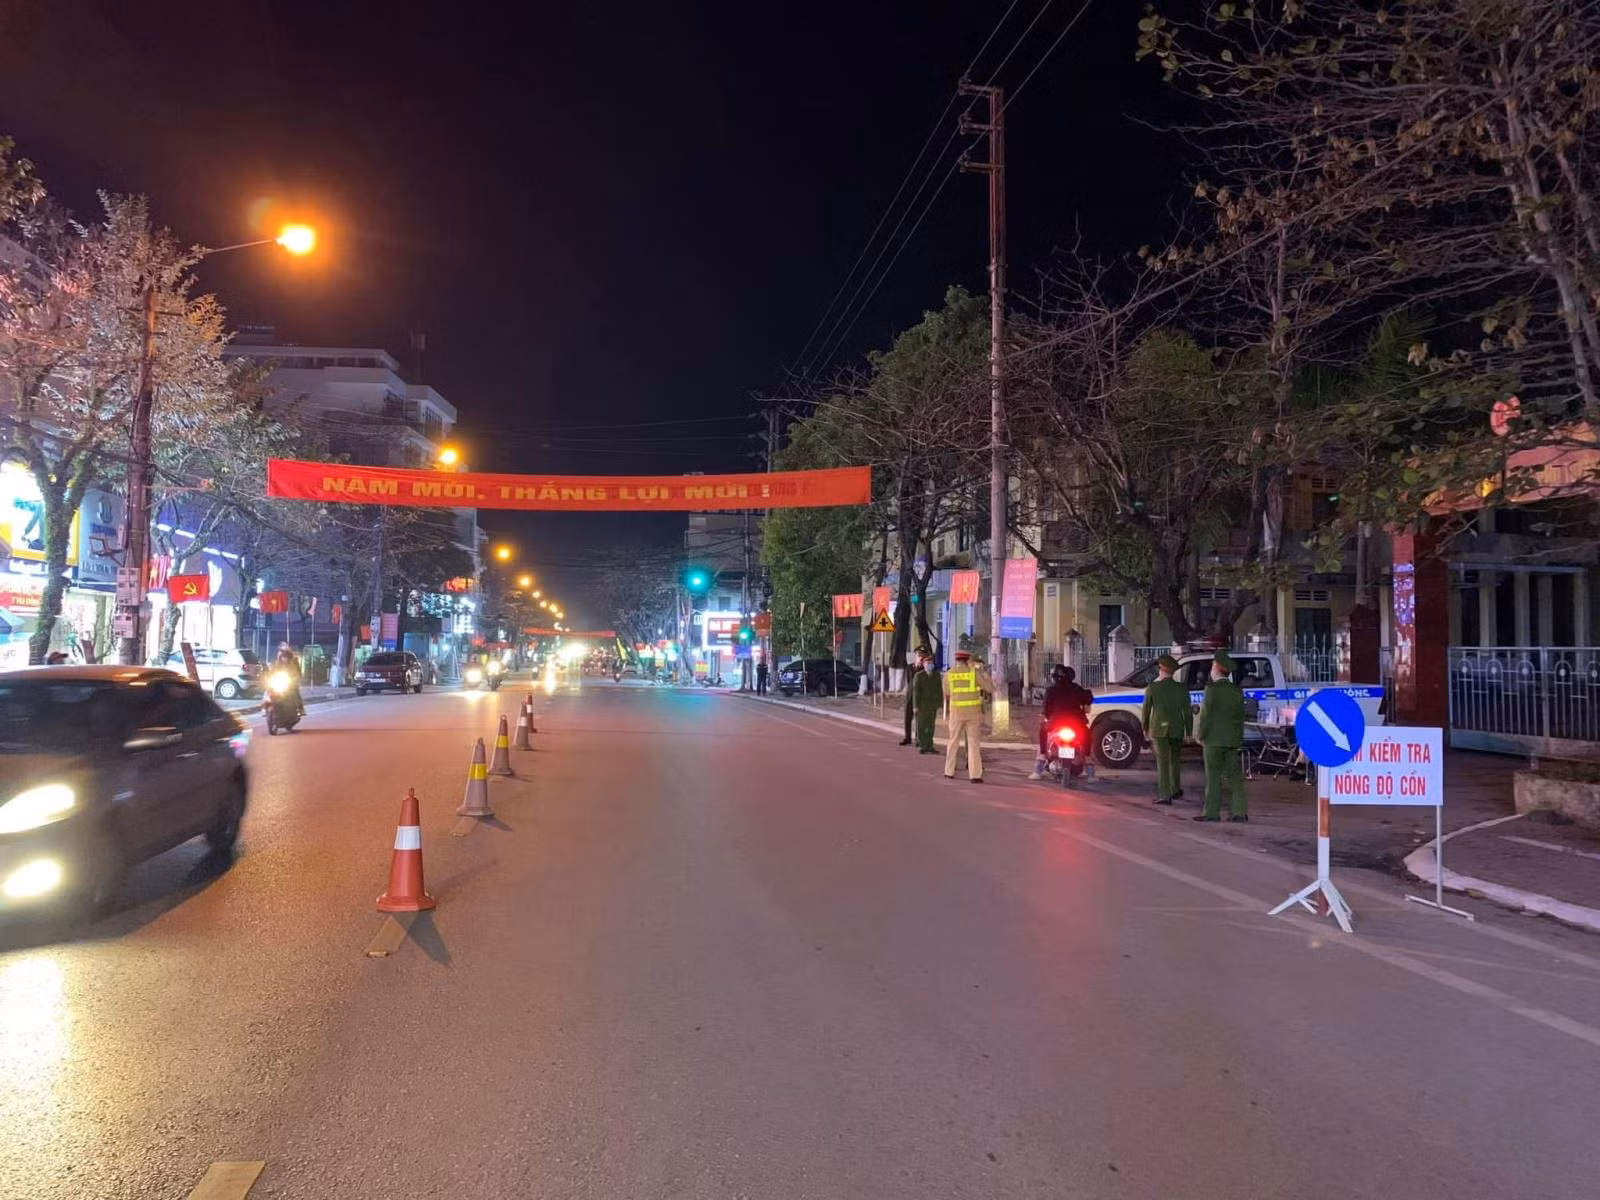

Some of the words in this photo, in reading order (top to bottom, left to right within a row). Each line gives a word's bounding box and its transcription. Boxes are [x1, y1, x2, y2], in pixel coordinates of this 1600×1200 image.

[497, 481, 607, 500] THẮNG
[1370, 736, 1401, 763] KIỂM
[1407, 743, 1431, 764] TRA
[1335, 770, 1370, 794] NỒNG
[1377, 772, 1393, 799] ĐỘ
[1400, 770, 1425, 795] CỒN
